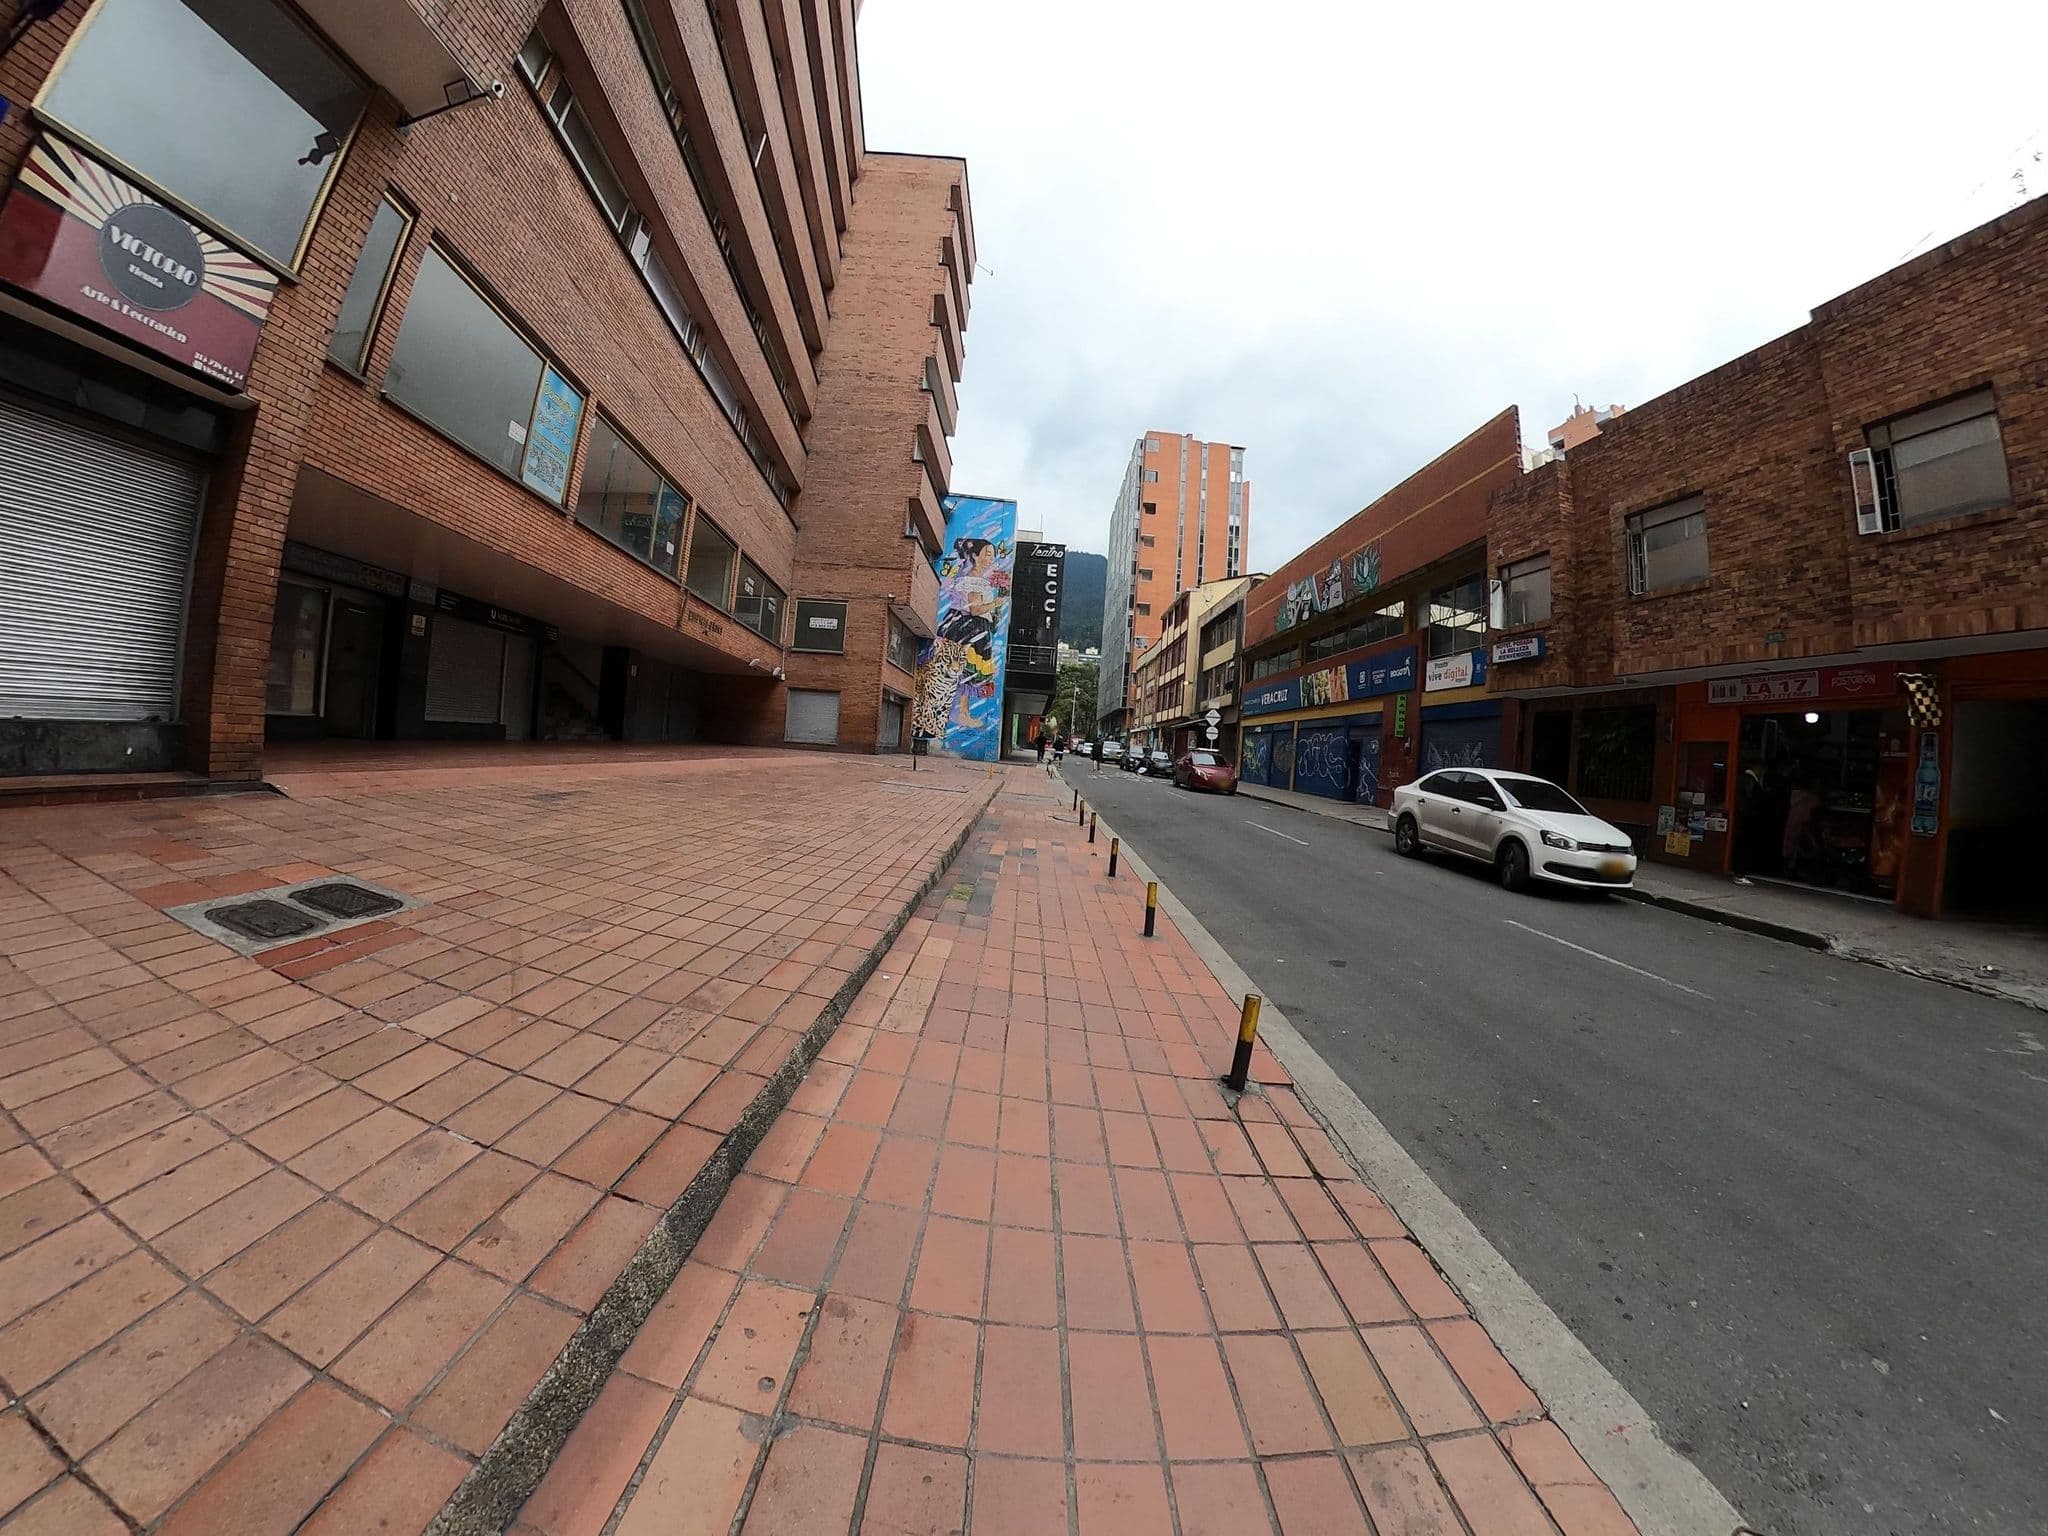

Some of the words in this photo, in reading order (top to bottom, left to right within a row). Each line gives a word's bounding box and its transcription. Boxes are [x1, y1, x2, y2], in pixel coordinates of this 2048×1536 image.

[110, 225, 198, 286] VICTORIO
[1030, 543, 1064, 559] Teatro
[1044, 563, 1058, 630] ECCI
[1443, 665, 1468, 682] digital
[1746, 682, 1771, 696] LA
[1779, 679, 1809, 693] 17
[1260, 688, 1289, 706] VERACRUZ
